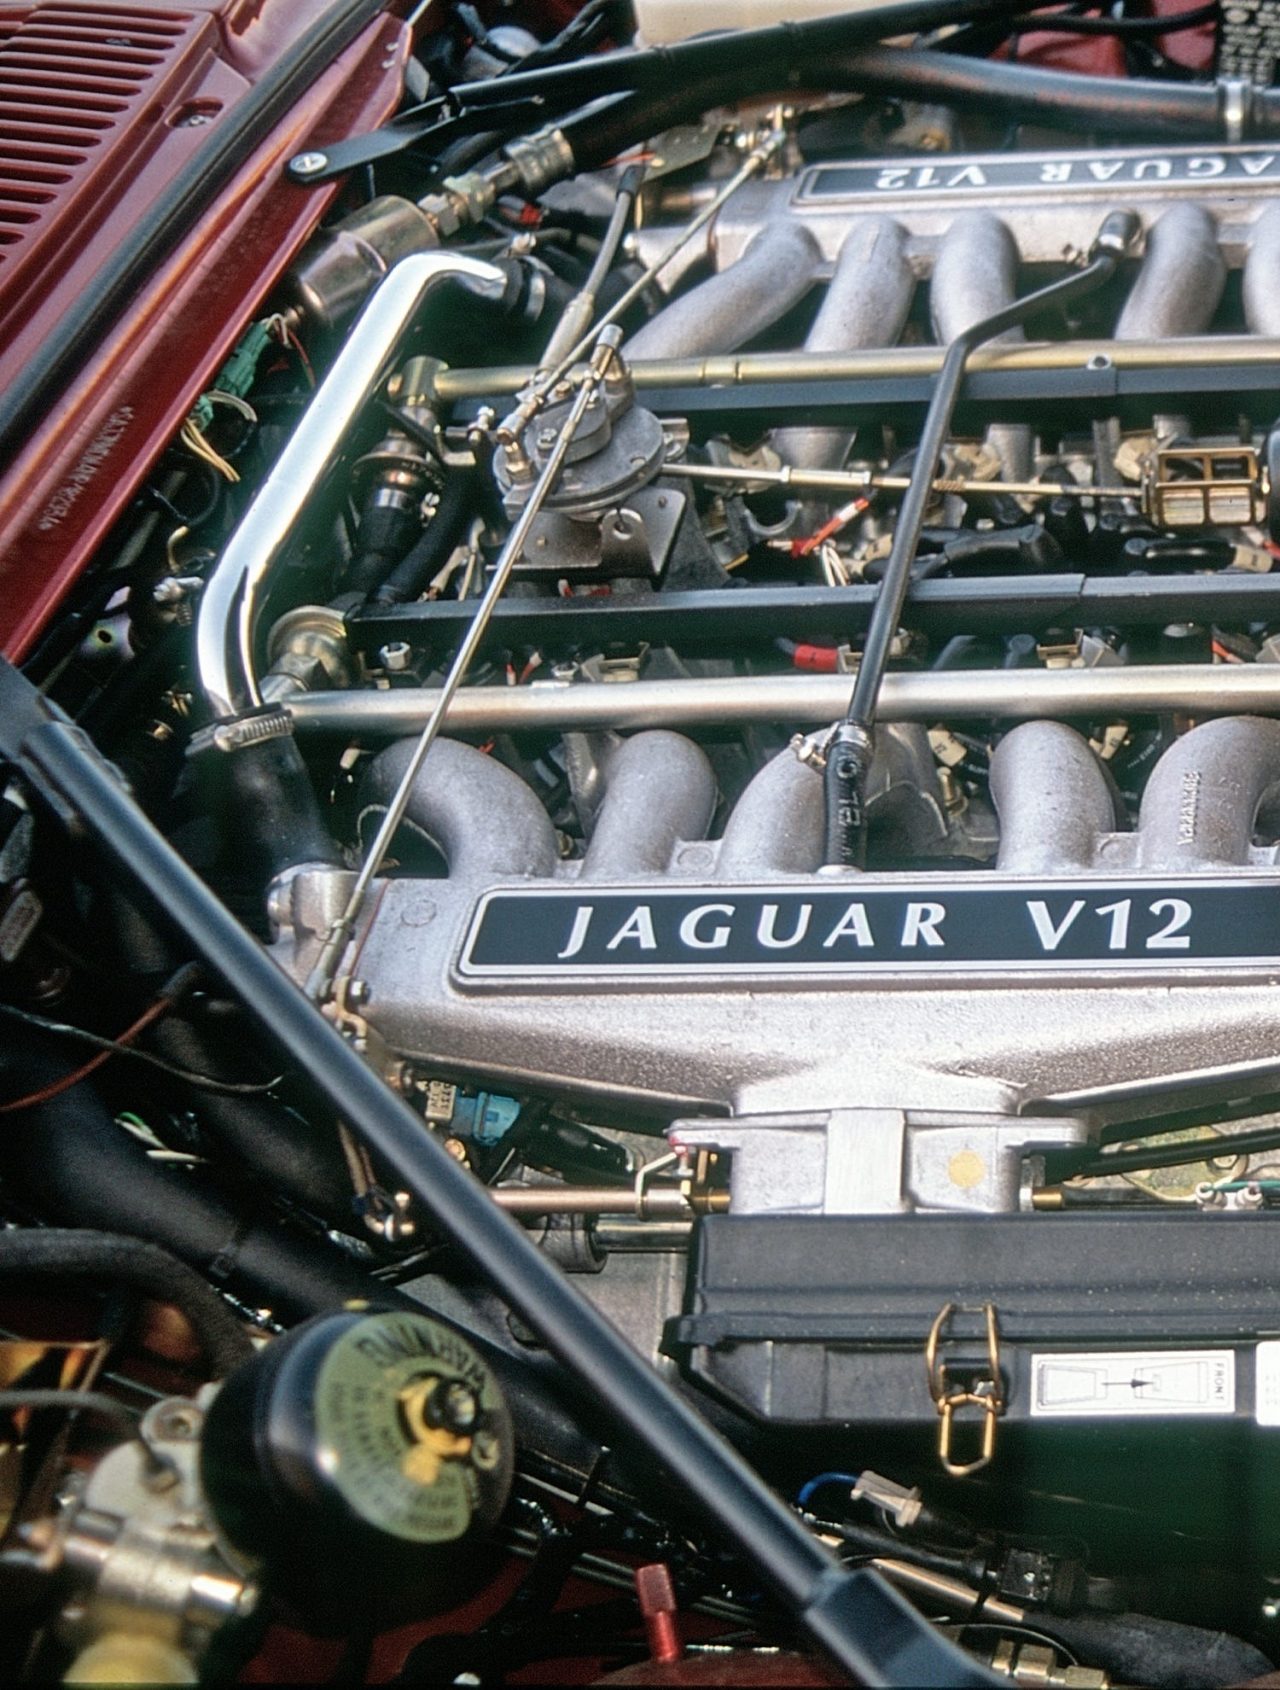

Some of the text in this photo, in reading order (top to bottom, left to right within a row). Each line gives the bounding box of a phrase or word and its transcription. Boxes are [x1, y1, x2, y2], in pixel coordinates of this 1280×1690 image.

[875, 165, 988, 190] V12
[557, 898, 1193, 958] JAGUAR V12
[1214, 1362, 1225, 1400] FRONT
